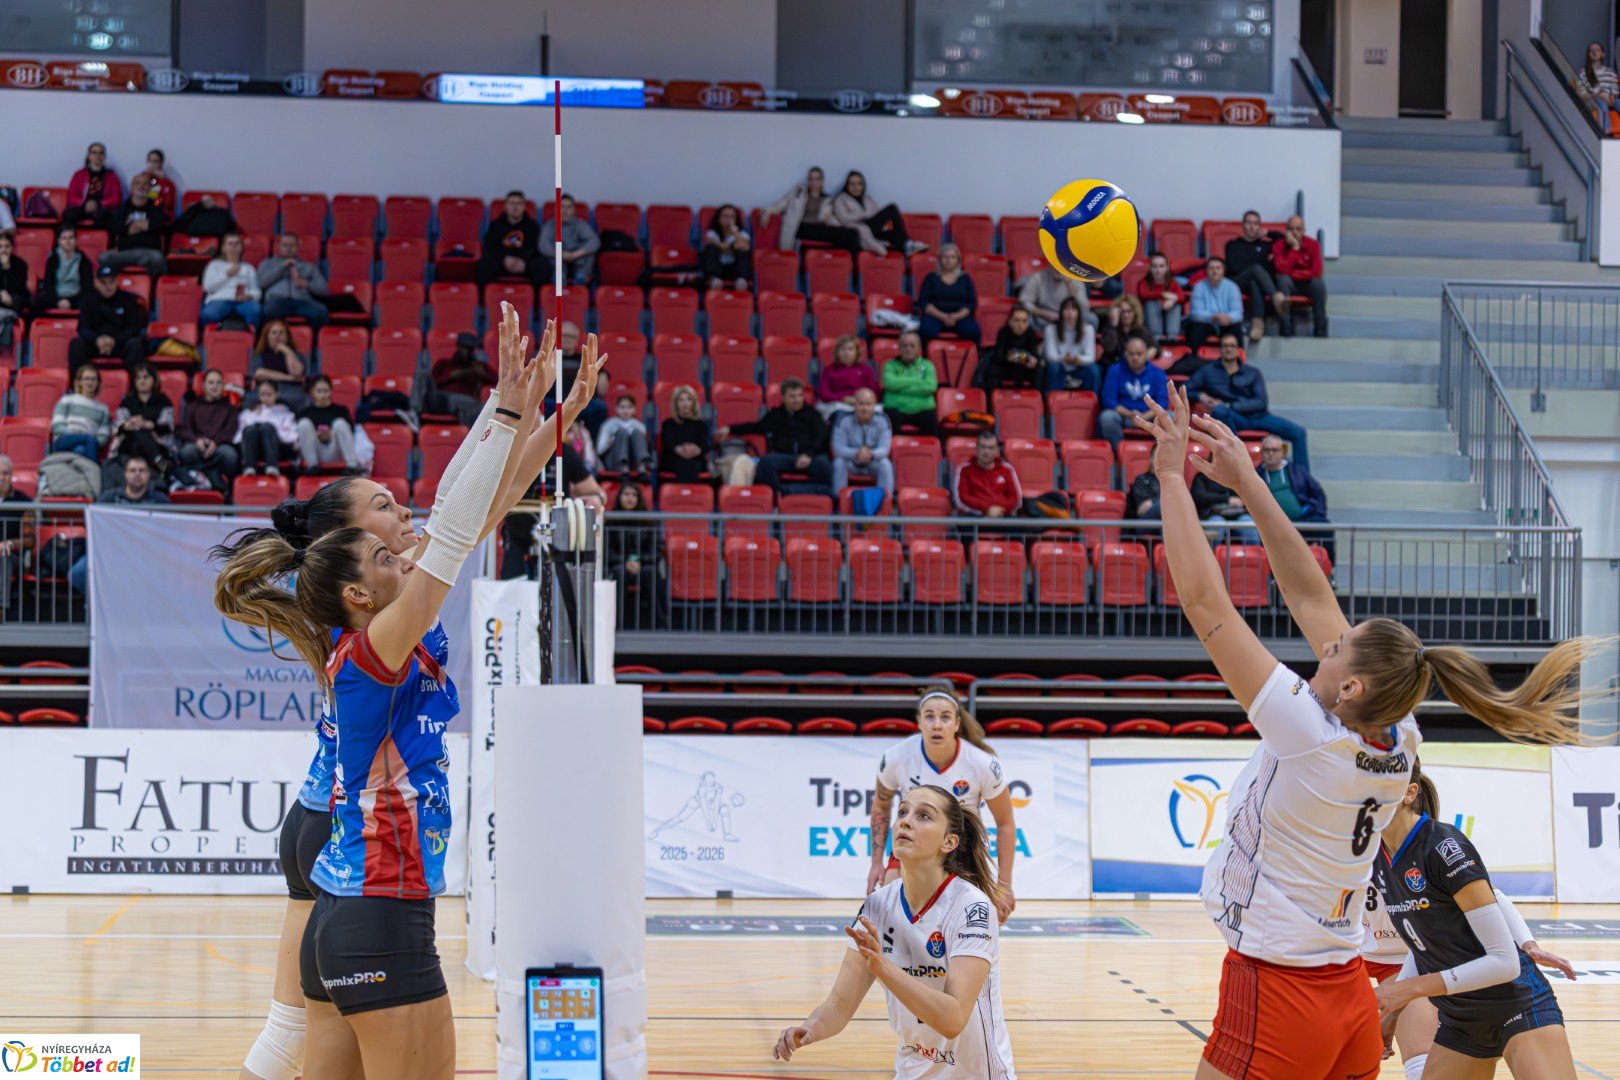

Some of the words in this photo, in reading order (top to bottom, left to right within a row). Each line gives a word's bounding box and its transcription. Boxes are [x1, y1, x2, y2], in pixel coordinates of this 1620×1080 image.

[416, 714, 448, 735] Tip
[70, 747, 293, 833] FATU
[423, 807, 449, 817] PRO
[1572, 792, 1620, 849] T
[1352, 797, 1382, 857] 6
[660, 846, 688, 861] 2025
[697, 846, 725, 861] 2026
[71, 860, 282, 874] INGATLANBERUHÁ
[1365, 886, 1378, 912] 3
[320, 970, 387, 991] ippmixPRO
